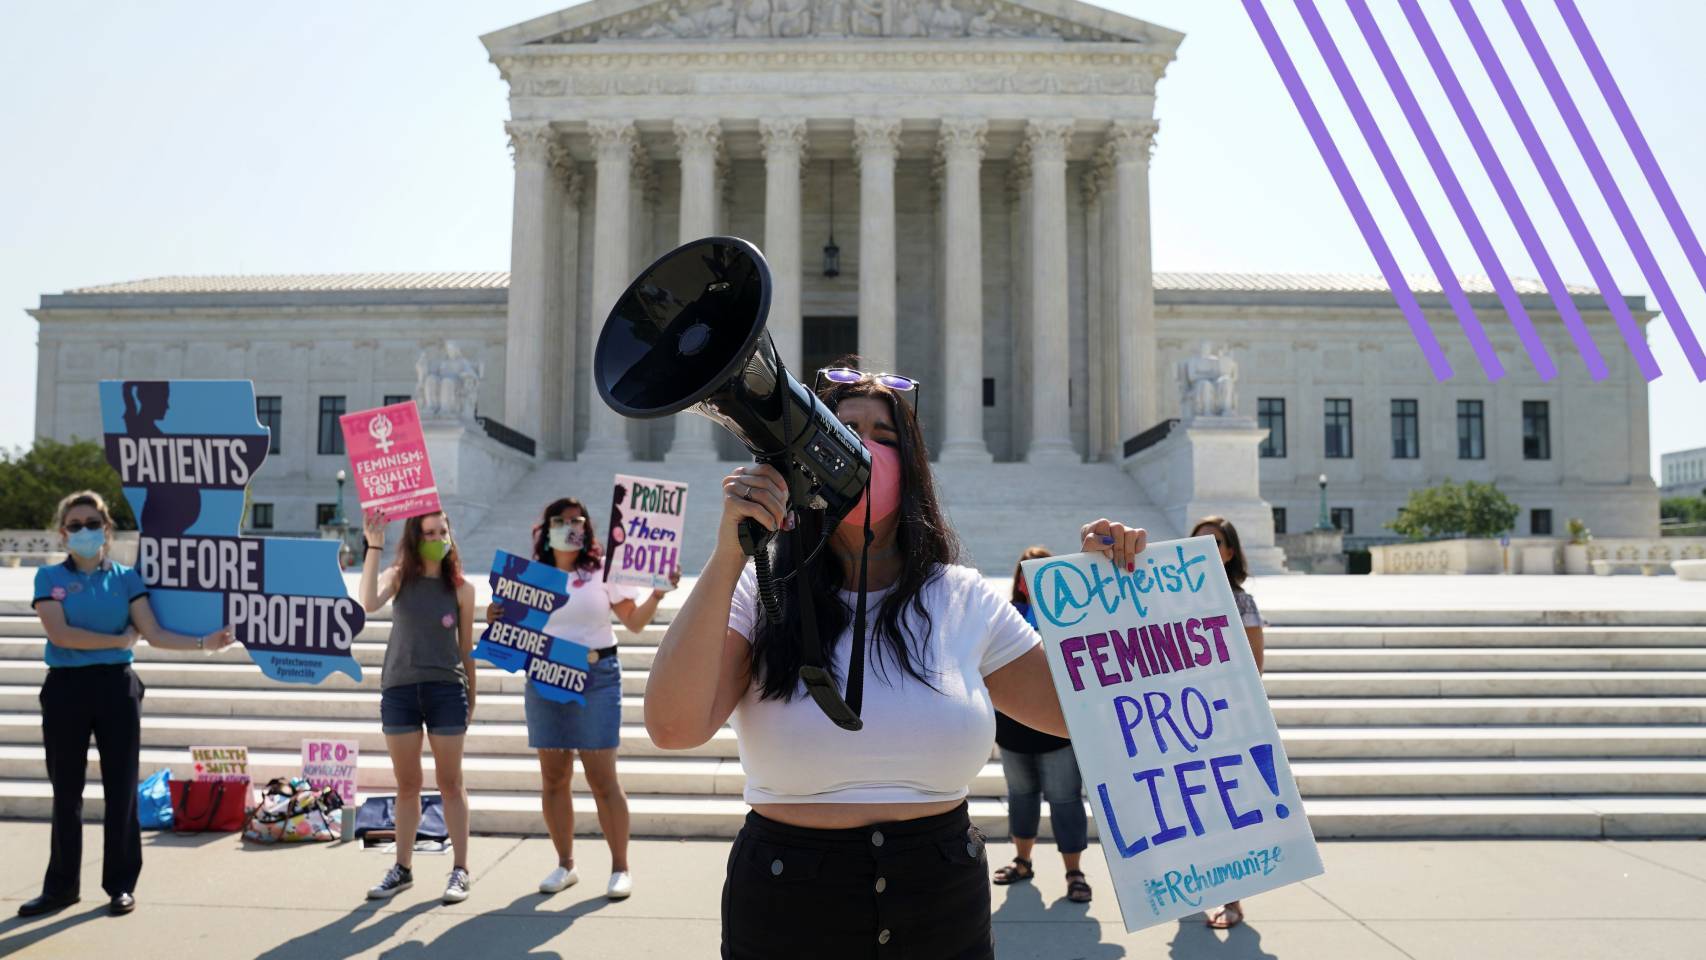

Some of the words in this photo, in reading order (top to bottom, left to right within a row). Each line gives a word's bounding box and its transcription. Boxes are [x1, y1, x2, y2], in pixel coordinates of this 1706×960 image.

[118, 437, 250, 485] PATIENTS
[357, 450, 424, 475] FEMINISM:
[363, 465, 422, 489] EQUALITY
[369, 484, 394, 498] FOR
[631, 482, 686, 516] PROTECT
[628, 517, 676, 542] them
[140, 536, 259, 591] BEFORE
[622, 543, 677, 579] BOTH
[496, 576, 555, 612] PATIENTS
[228, 593, 354, 650] PROFITS
[489, 621, 548, 657] BEFORE
[1060, 615, 1230, 692] FEMINIST
[527, 657, 588, 692] PROFITS
[1113, 687, 1229, 758] PRO-
[192, 749, 246, 761] HEALTH
[1097, 744, 1291, 859] LIFE!
[1143, 844, 1283, 916] #Rehumanize
